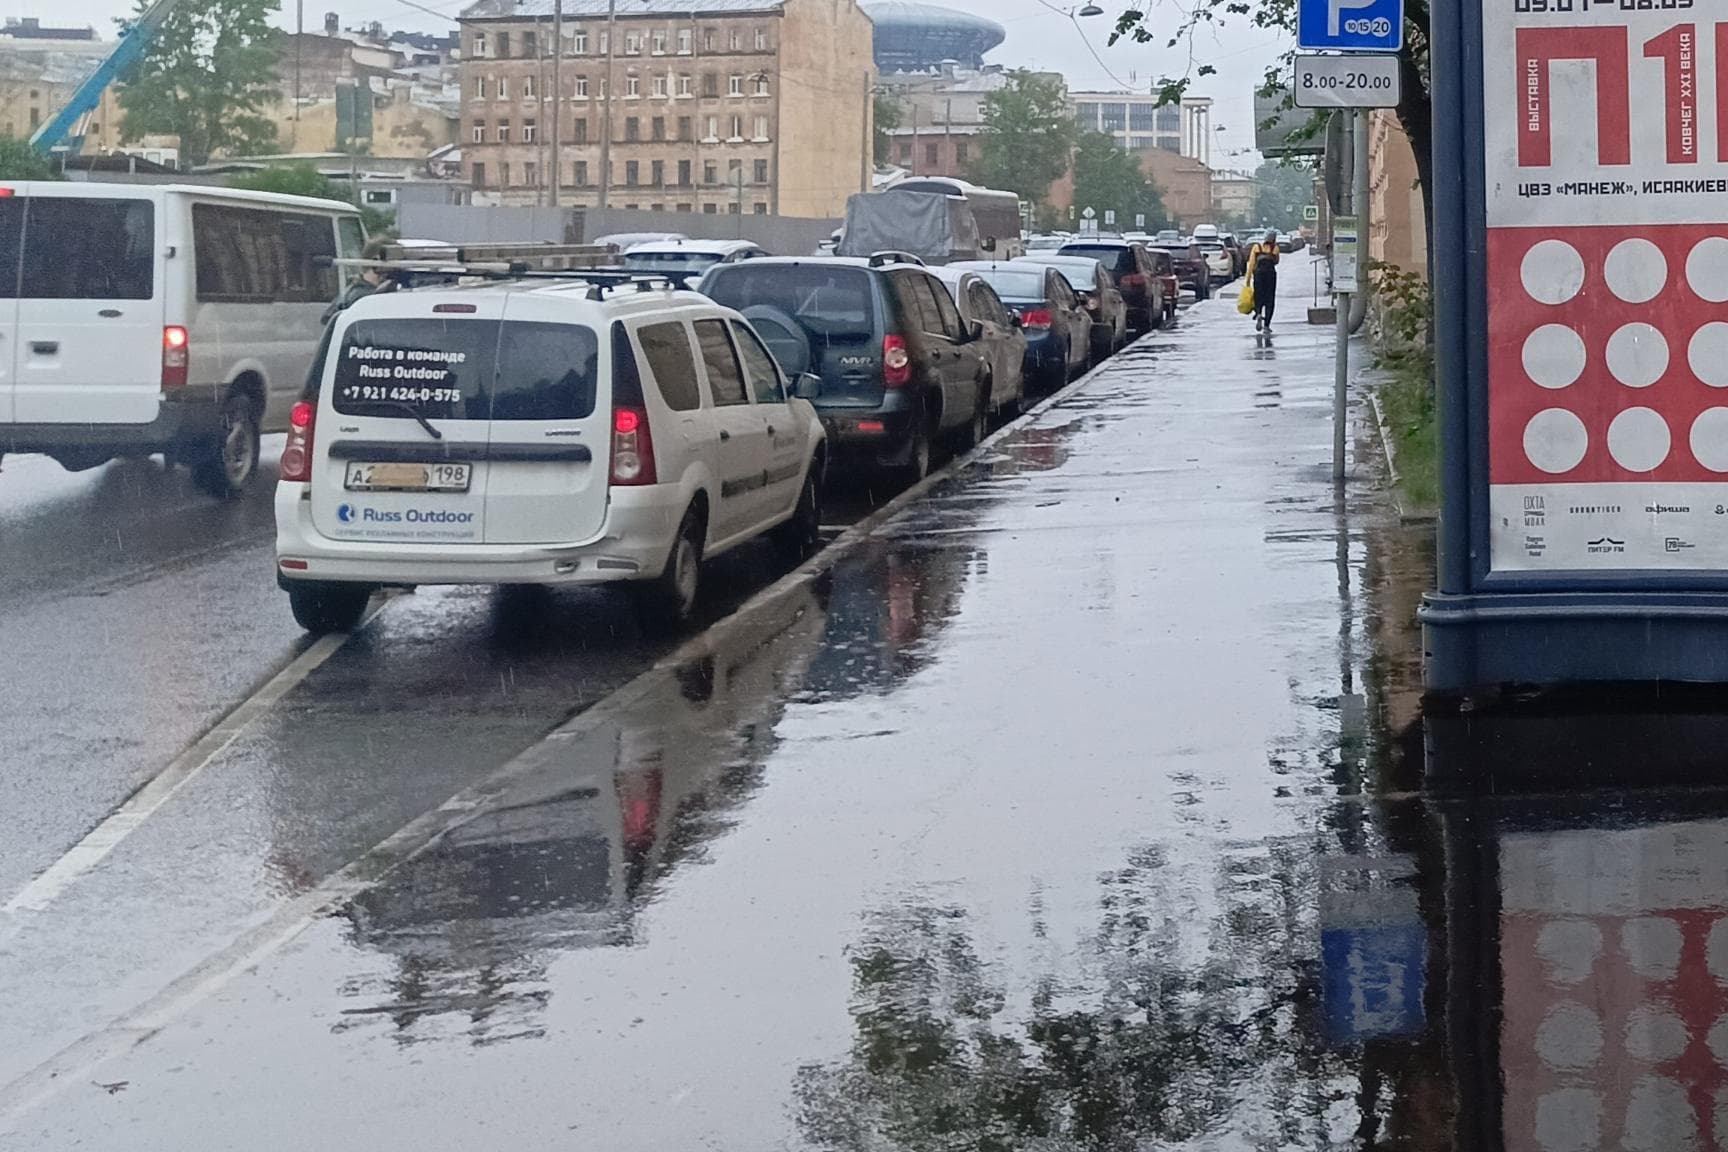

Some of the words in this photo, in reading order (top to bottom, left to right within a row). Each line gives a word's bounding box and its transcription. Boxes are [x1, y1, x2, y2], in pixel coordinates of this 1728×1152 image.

[1347, 22, 1356, 31] 10
[1359, 22, 1369, 32] 15
[1373, 21, 1389, 33] 20
[1680, 33, 1691, 69] ВЕКА
[1302, 72, 1391, 89] 8.00-20.00
[1527, 59, 1540, 131] ВЫСТАВКА
[1681, 101, 1693, 155] КОВЧЕГ
[1518, 183, 1551, 198] ЦВЗ
[1556, 181, 1637, 196] «МАНЕЖ»,
[348, 346, 393, 360] Работа
[396, 350, 404, 360] в
[407, 351, 466, 363] команде
[360, 365, 391, 378] Russ
[394, 366, 448, 380] Outdoor
[343, 386, 360, 399] +7
[363, 386, 387, 400] 921
[390, 387, 461, 402] 424-0-575
[435, 466, 464, 481] 198
[363, 508, 402, 522] Russ
[405, 509, 474, 523] Outdoor
